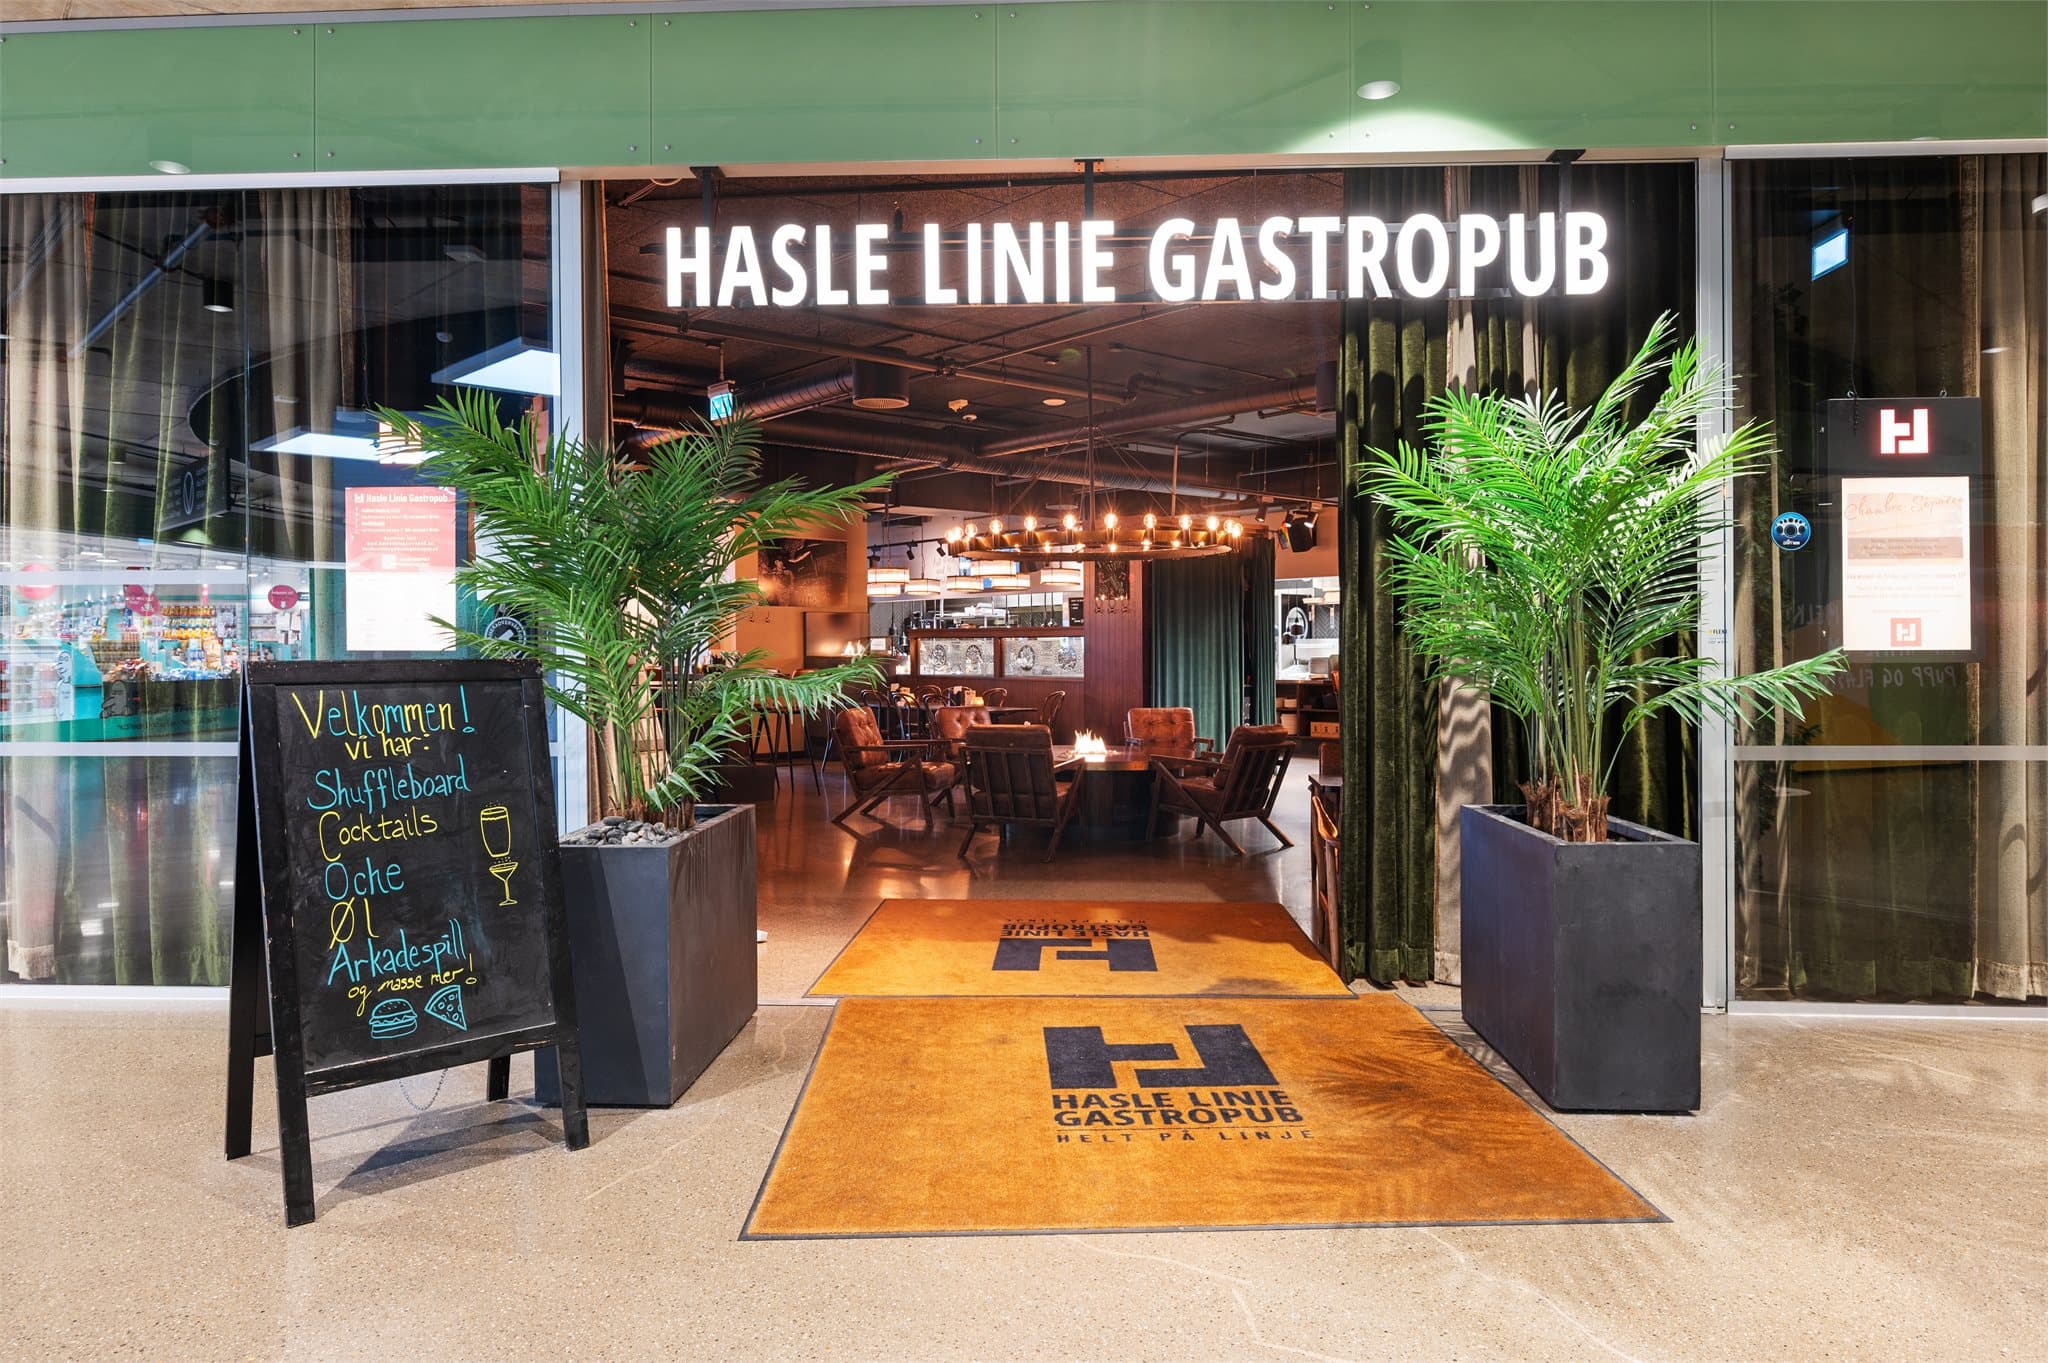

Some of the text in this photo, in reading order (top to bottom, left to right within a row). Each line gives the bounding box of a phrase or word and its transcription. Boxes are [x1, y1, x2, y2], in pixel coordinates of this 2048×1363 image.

[665, 211, 1609, 307] HASLE LINIE GASTROPUB
[366, 493, 448, 504] Hasle Linie Gastropub
[345, 735, 372, 760] vi
[307, 753, 471, 814] Shuffleboard
[319, 805, 438, 862] Cocktails
[325, 857, 404, 900] Oche
[328, 918, 467, 986] Arkadespill
[348, 983, 372, 1017] og
[377, 973, 424, 993] masse
[1052, 1090, 1294, 1109] HASLE LINIE
[1055, 1106, 1303, 1127] GASTROPUB
[1057, 1129, 1315, 1143] HELT PÅ LINJE
